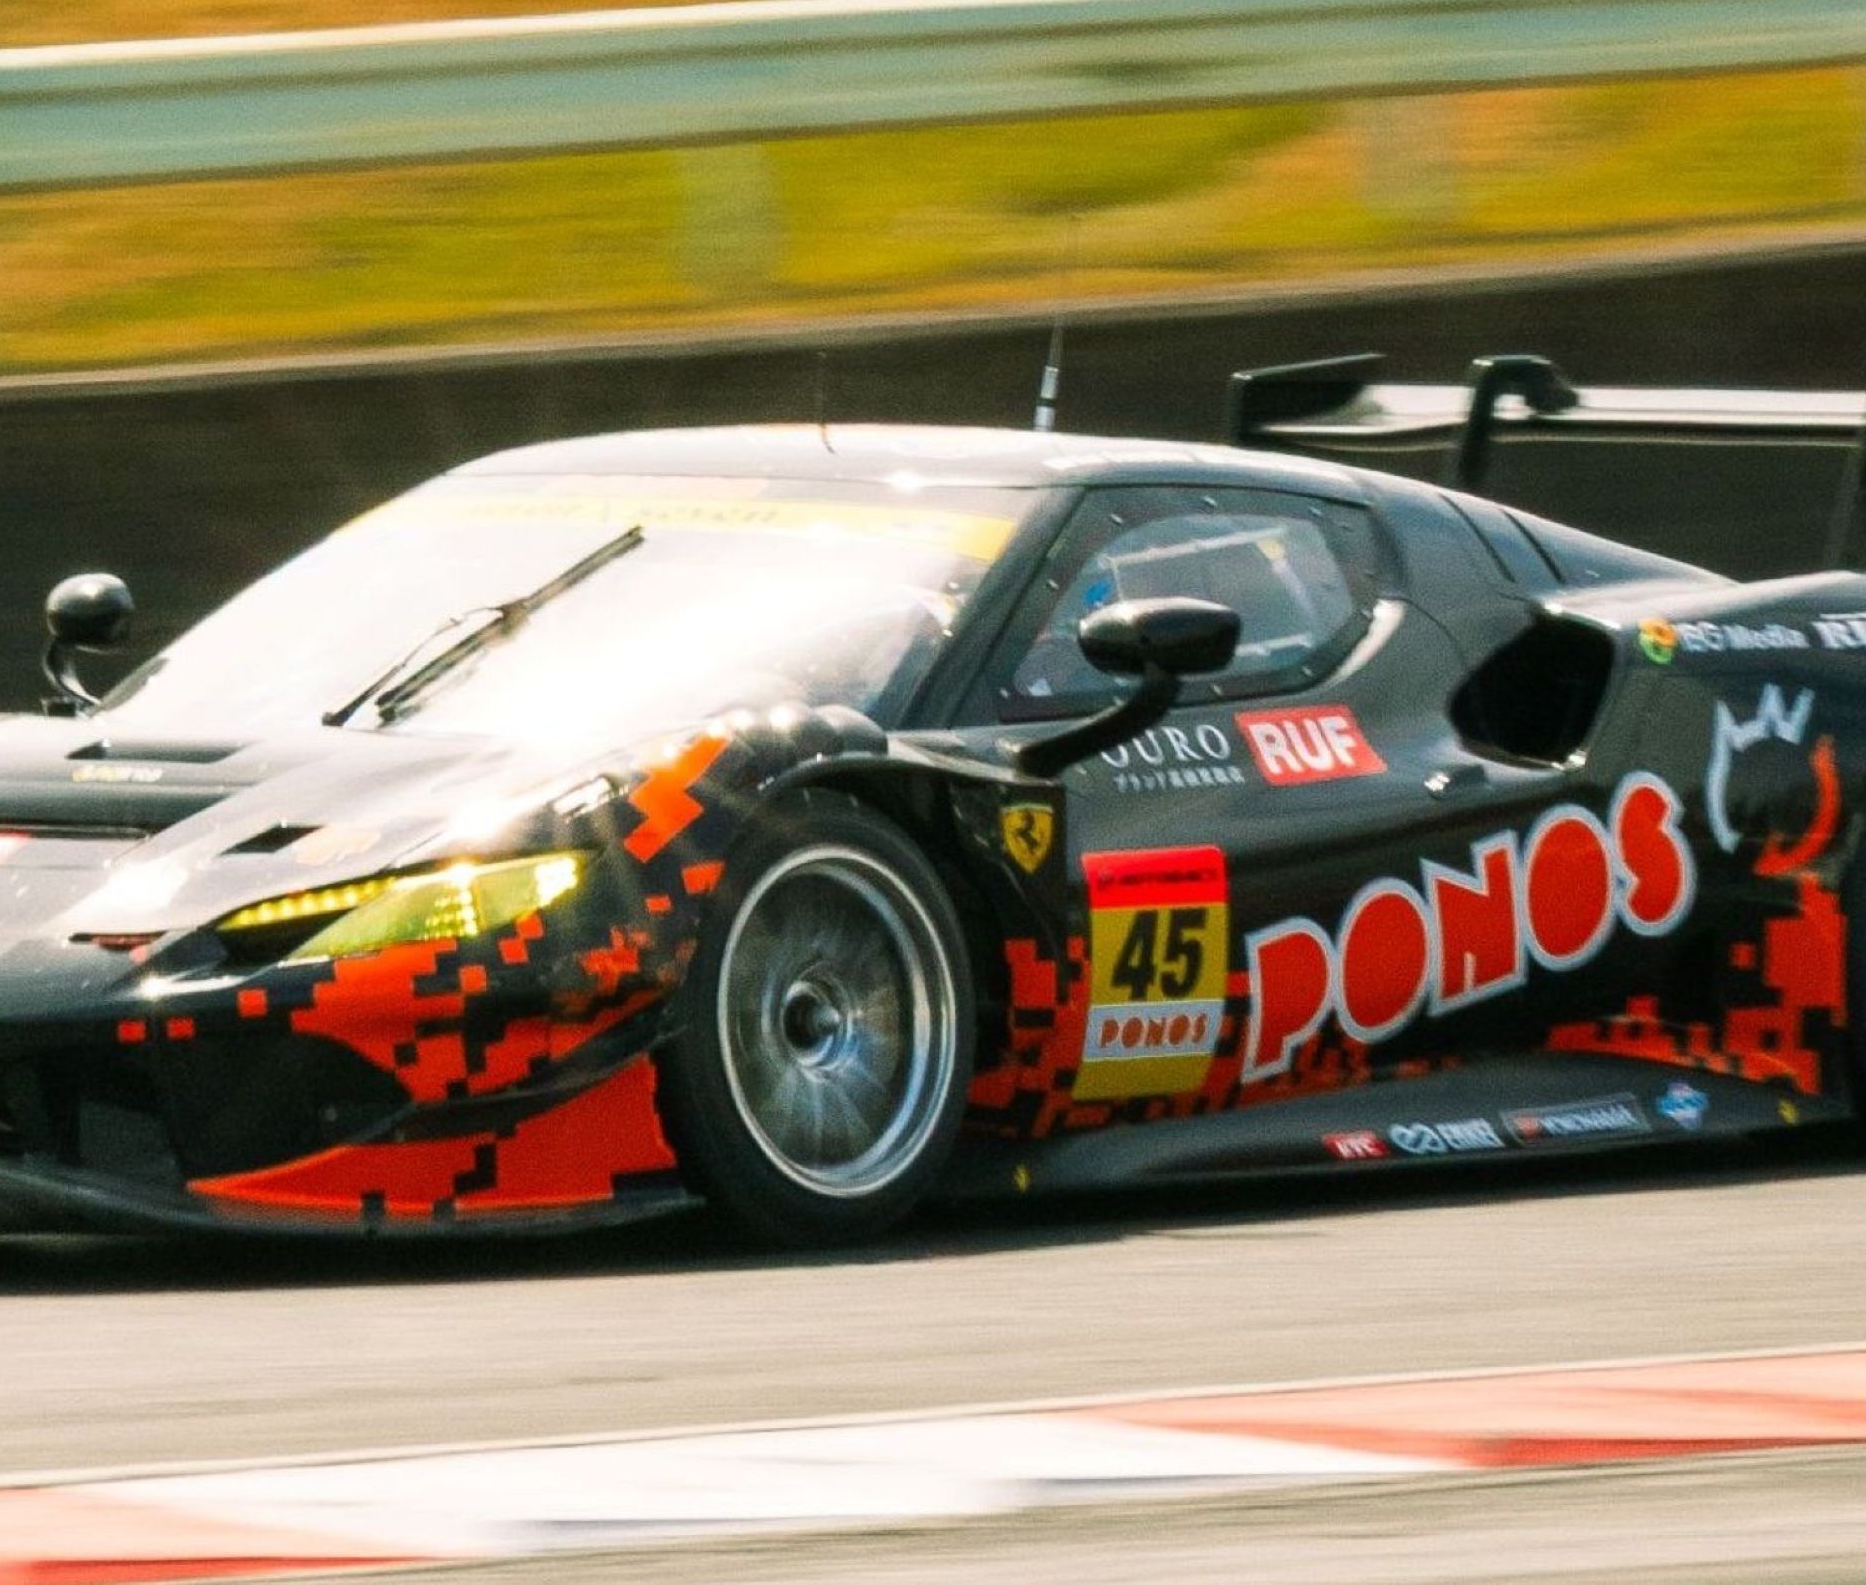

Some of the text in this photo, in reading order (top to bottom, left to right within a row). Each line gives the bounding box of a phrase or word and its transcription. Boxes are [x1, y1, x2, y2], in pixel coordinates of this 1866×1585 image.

[1248, 716, 1357, 775] RUF
[1111, 909, 1208, 1001] 45
[1242, 771, 1696, 1082] PONOS
[1100, 1013, 1208, 1049] PONOS
